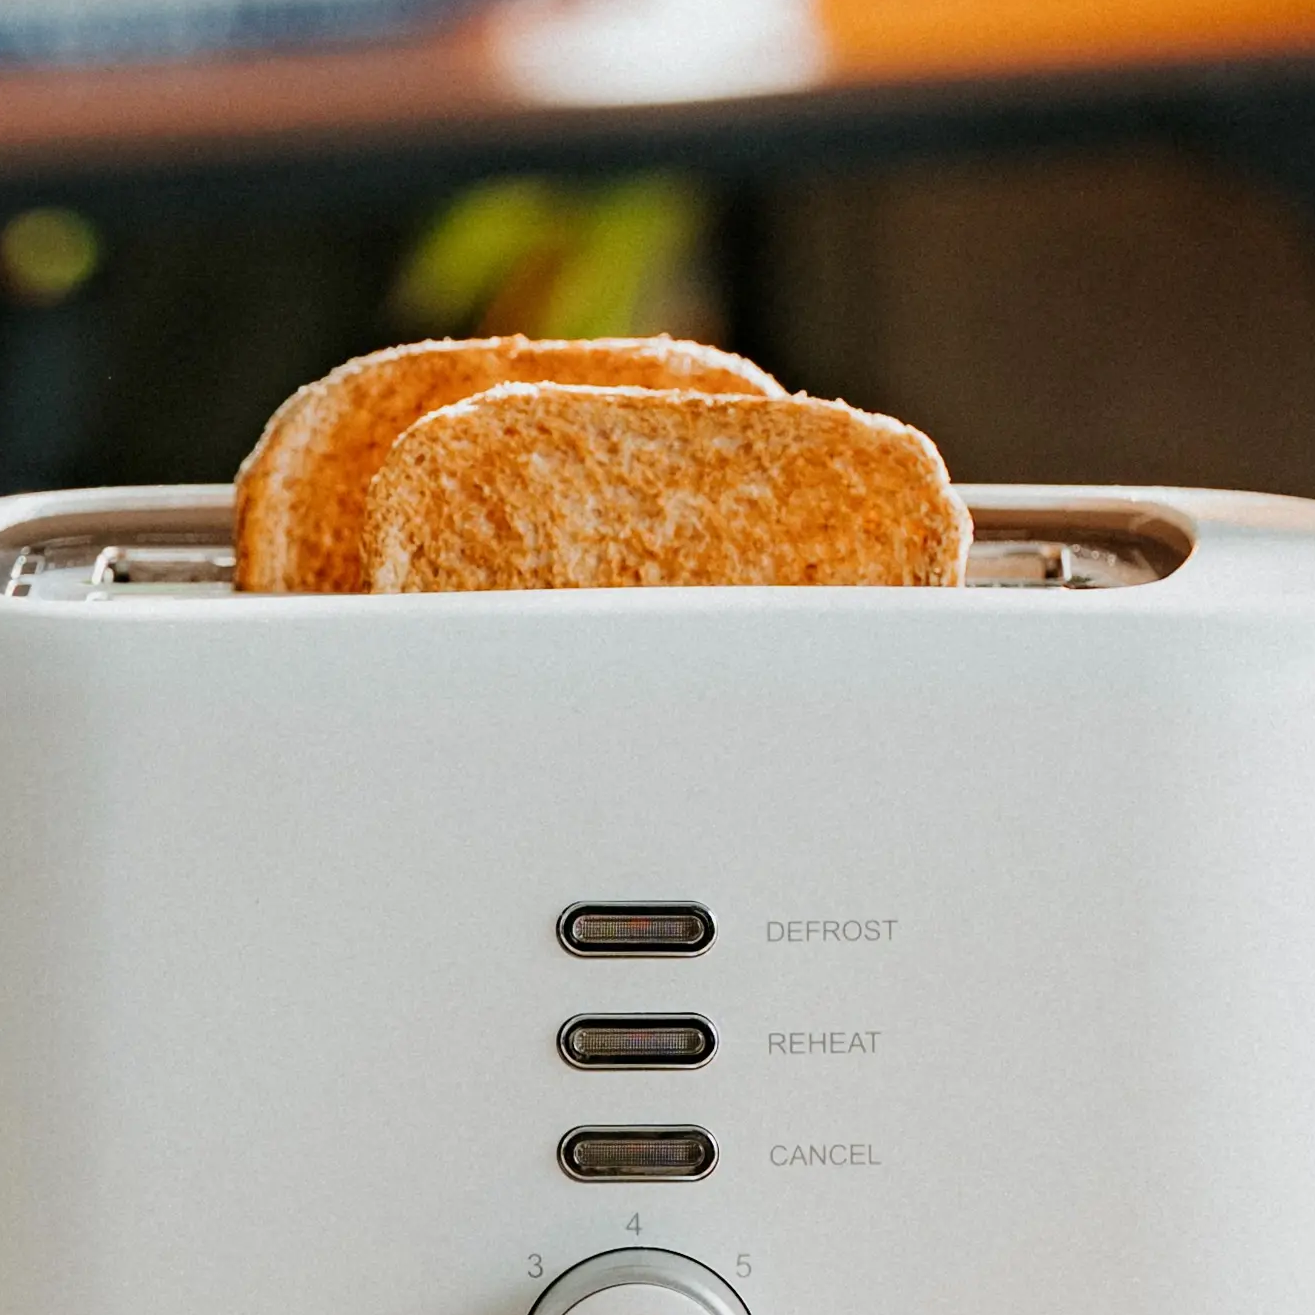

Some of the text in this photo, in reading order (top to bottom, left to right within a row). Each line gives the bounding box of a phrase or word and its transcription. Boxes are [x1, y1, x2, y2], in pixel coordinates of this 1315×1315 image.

[766, 919, 899, 943] DEFROST
[767, 1031, 882, 1055] REHEAT
[769, 1143, 881, 1167] CANCEL
[625, 1212, 643, 1236] 4
[527, 1253, 544, 1279] 3
[735, 1253, 753, 1279] 5
